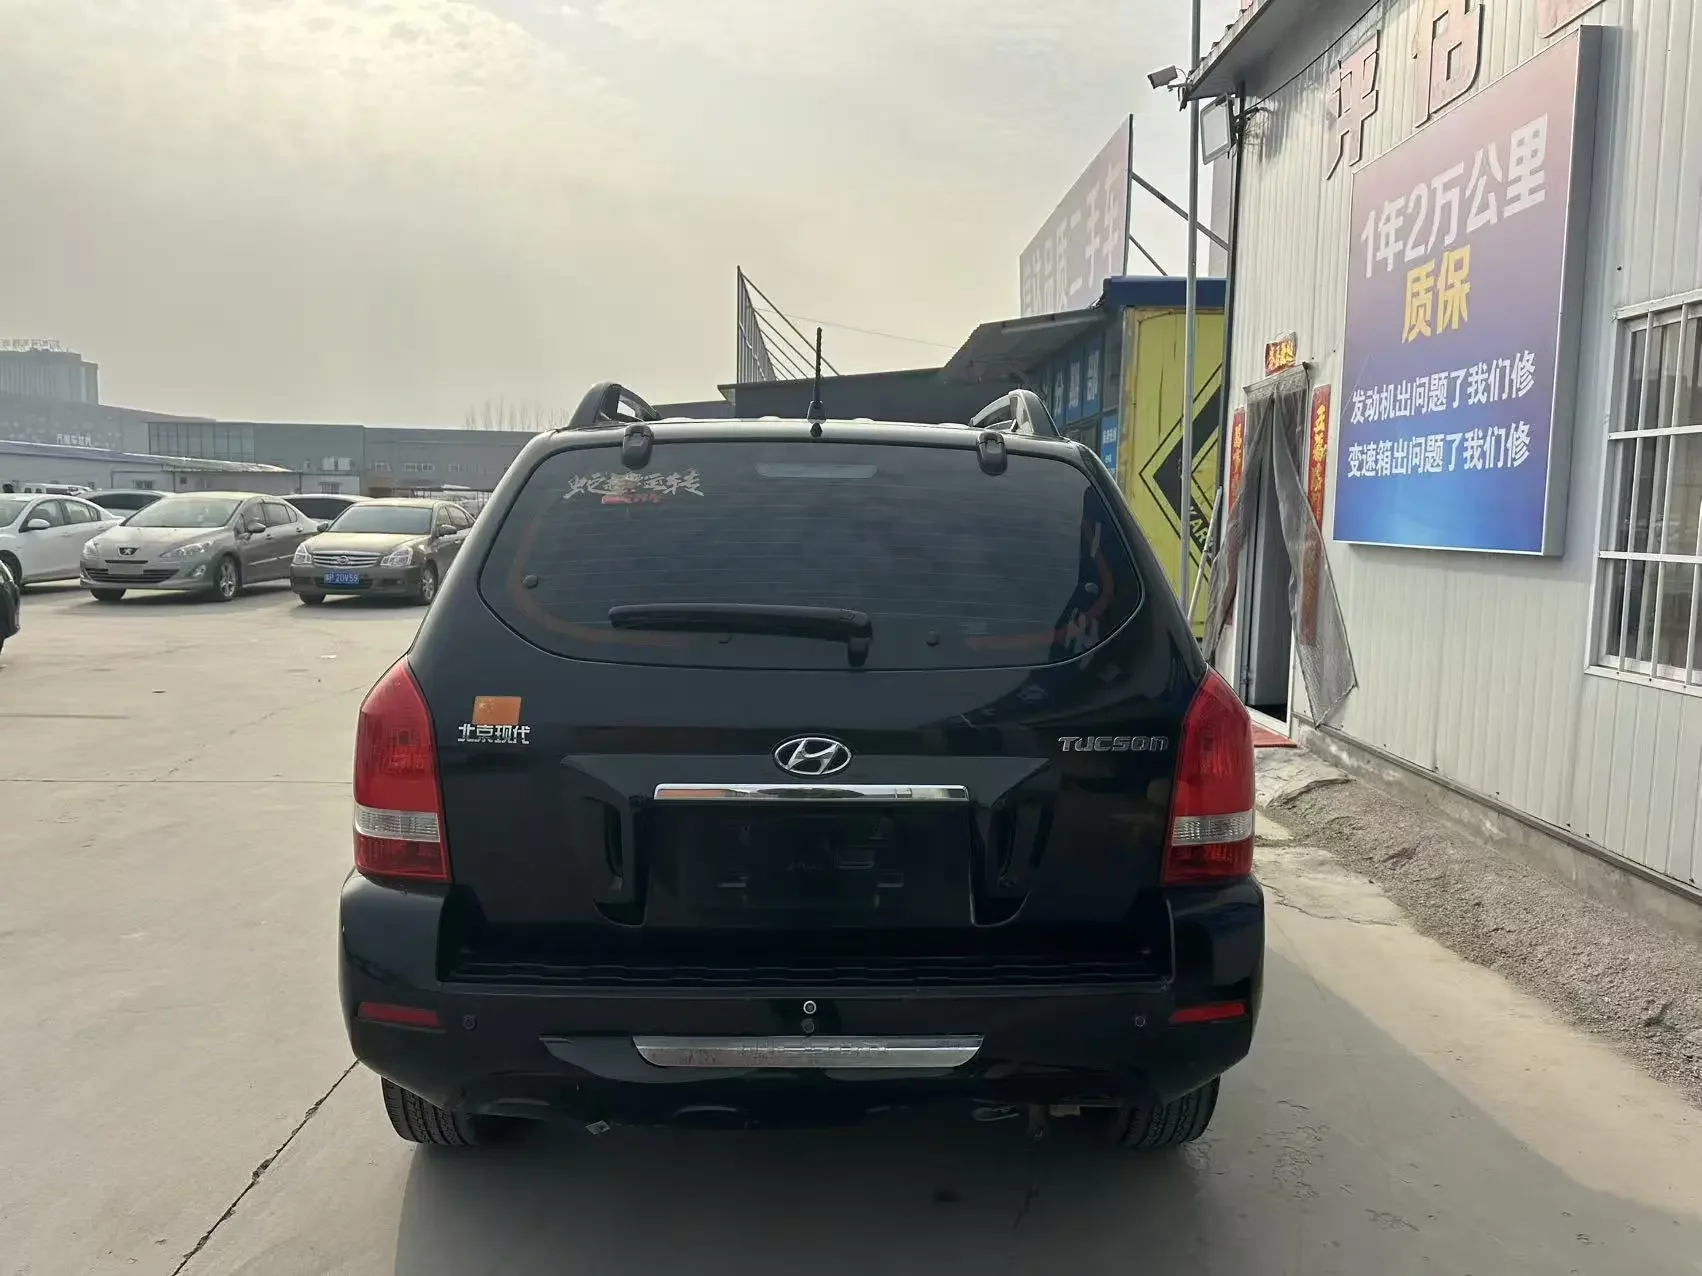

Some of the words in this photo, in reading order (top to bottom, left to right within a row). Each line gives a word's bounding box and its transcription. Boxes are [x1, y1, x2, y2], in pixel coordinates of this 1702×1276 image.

[1361, 113, 1548, 279] 1年2万公里
[1402, 244, 1471, 344] 质保
[1350, 350, 1537, 425] 发动机出问题了我们修
[1347, 420, 1532, 479] 变速箱出问题了我们修
[457, 723, 531, 745] 北京现代
[1058, 736, 1169, 752] TUCSON
